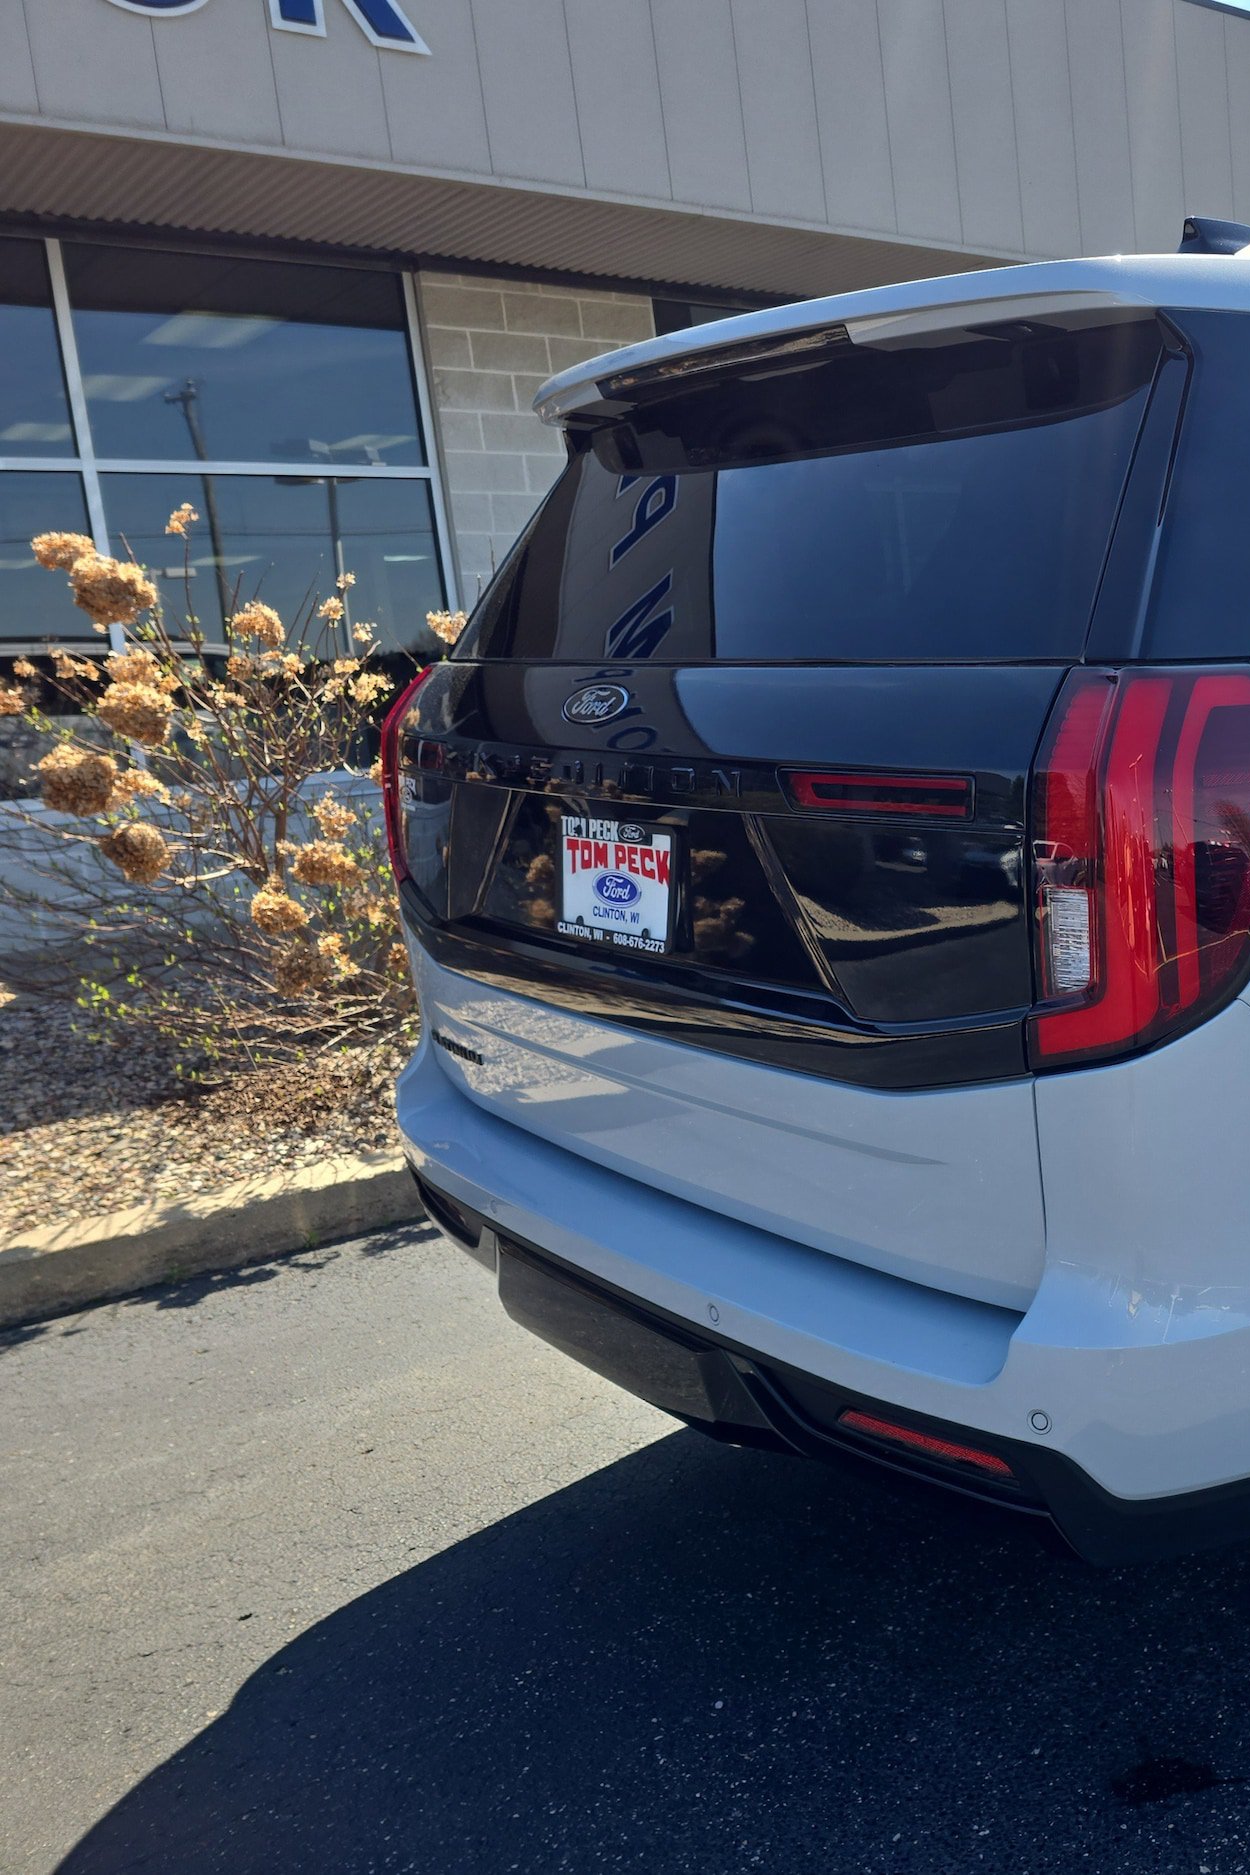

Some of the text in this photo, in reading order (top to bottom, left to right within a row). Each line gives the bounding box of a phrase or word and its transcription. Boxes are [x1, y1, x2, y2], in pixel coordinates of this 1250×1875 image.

[571, 689, 617, 716] Ford
[447, 749, 742, 799] XPEDITION
[588, 818, 620, 842] PECK
[566, 838, 671, 888] TOM PECK
[602, 875, 631, 901] Ford
[592, 905, 640, 924] CLINTON, WI
[557, 921, 592, 941] CLINTON,
[593, 929, 604, 941] WI
[612, 932, 665, 954] 608-676-2273
